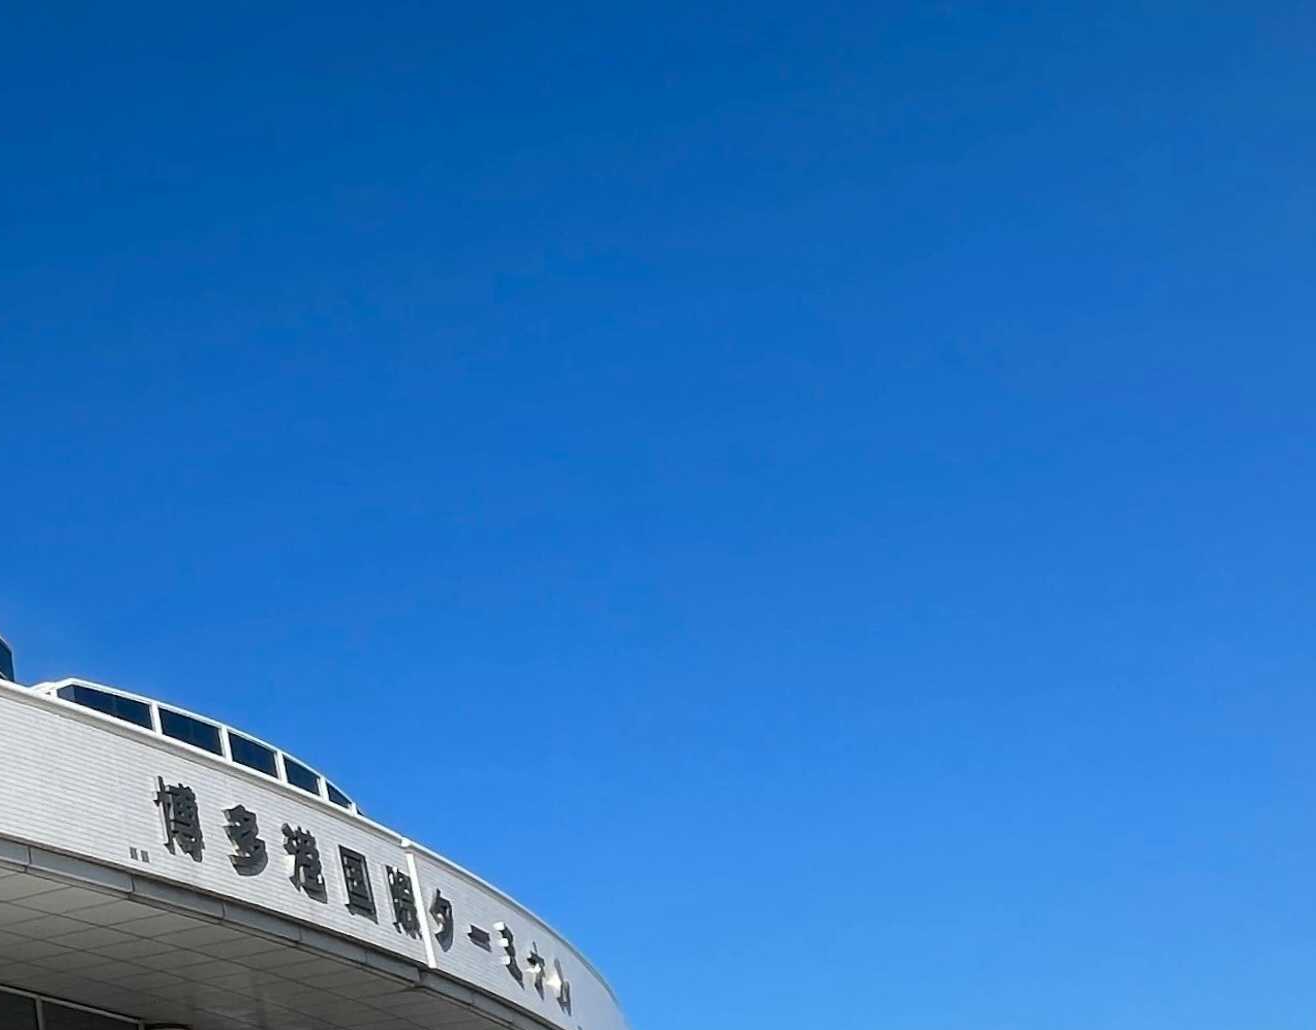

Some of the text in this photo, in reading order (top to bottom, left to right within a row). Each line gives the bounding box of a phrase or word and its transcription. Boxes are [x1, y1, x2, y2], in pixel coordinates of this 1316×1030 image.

[153, 775, 572, 1016] 博多港国際ターミナル
